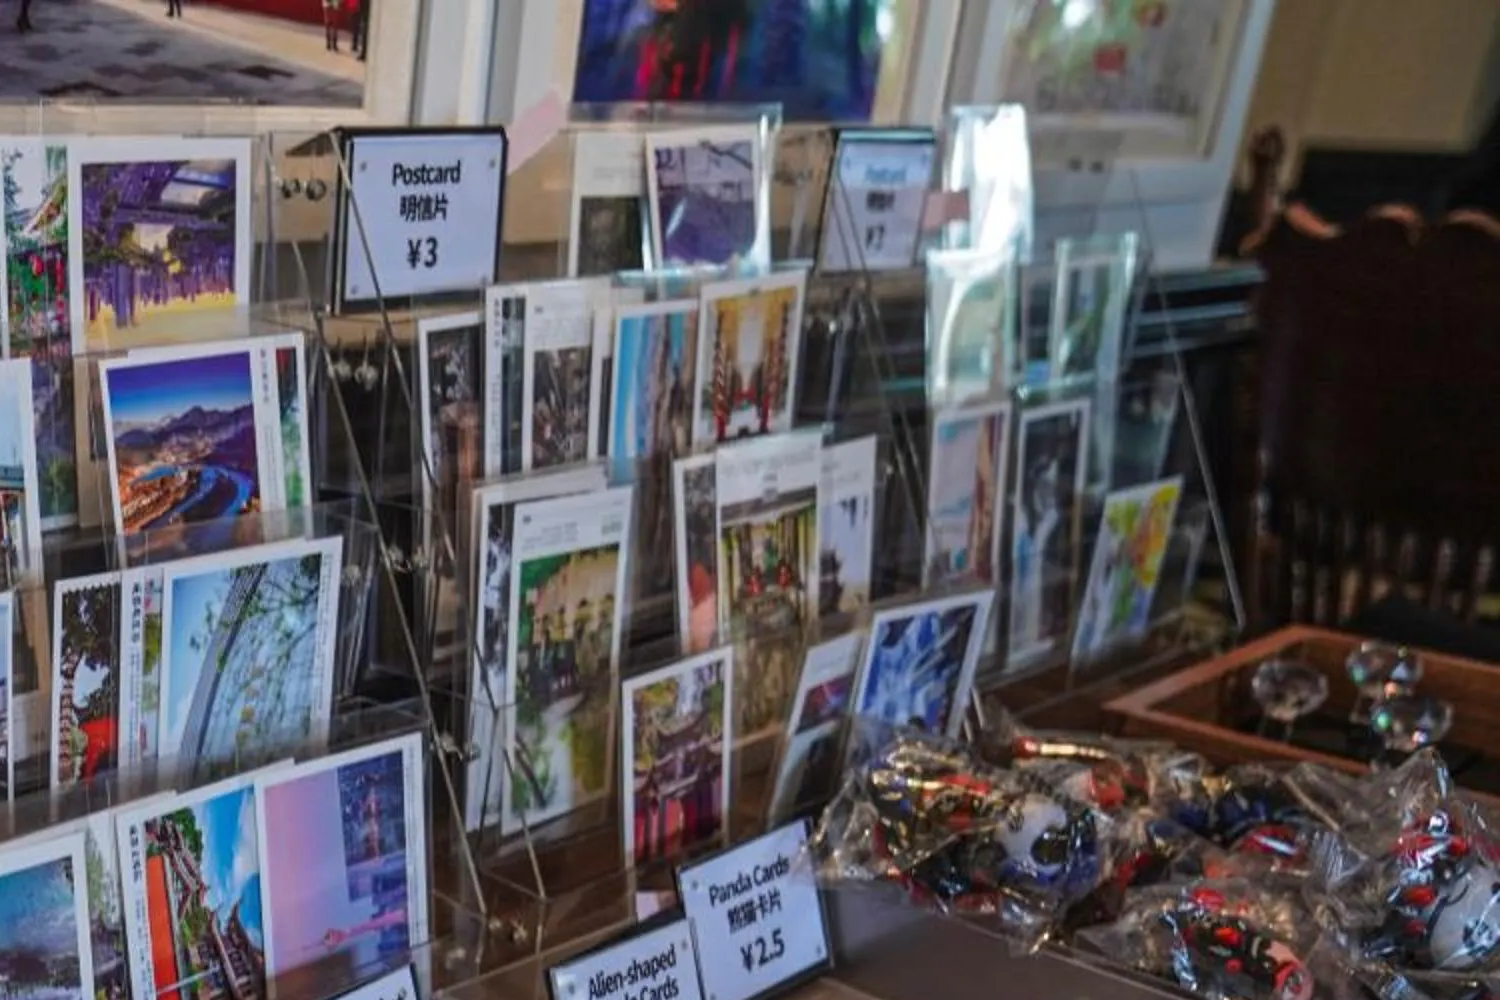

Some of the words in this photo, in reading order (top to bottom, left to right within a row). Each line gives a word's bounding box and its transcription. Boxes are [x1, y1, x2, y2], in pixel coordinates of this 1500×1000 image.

[392, 159, 461, 186] Postcard
[399, 192, 448, 221] 明信片
[407, 237, 438, 269] ¥3
[709, 870, 752, 906] Panda
[752, 853, 790, 885] Cards
[740, 928, 786, 973] ¥2.5
